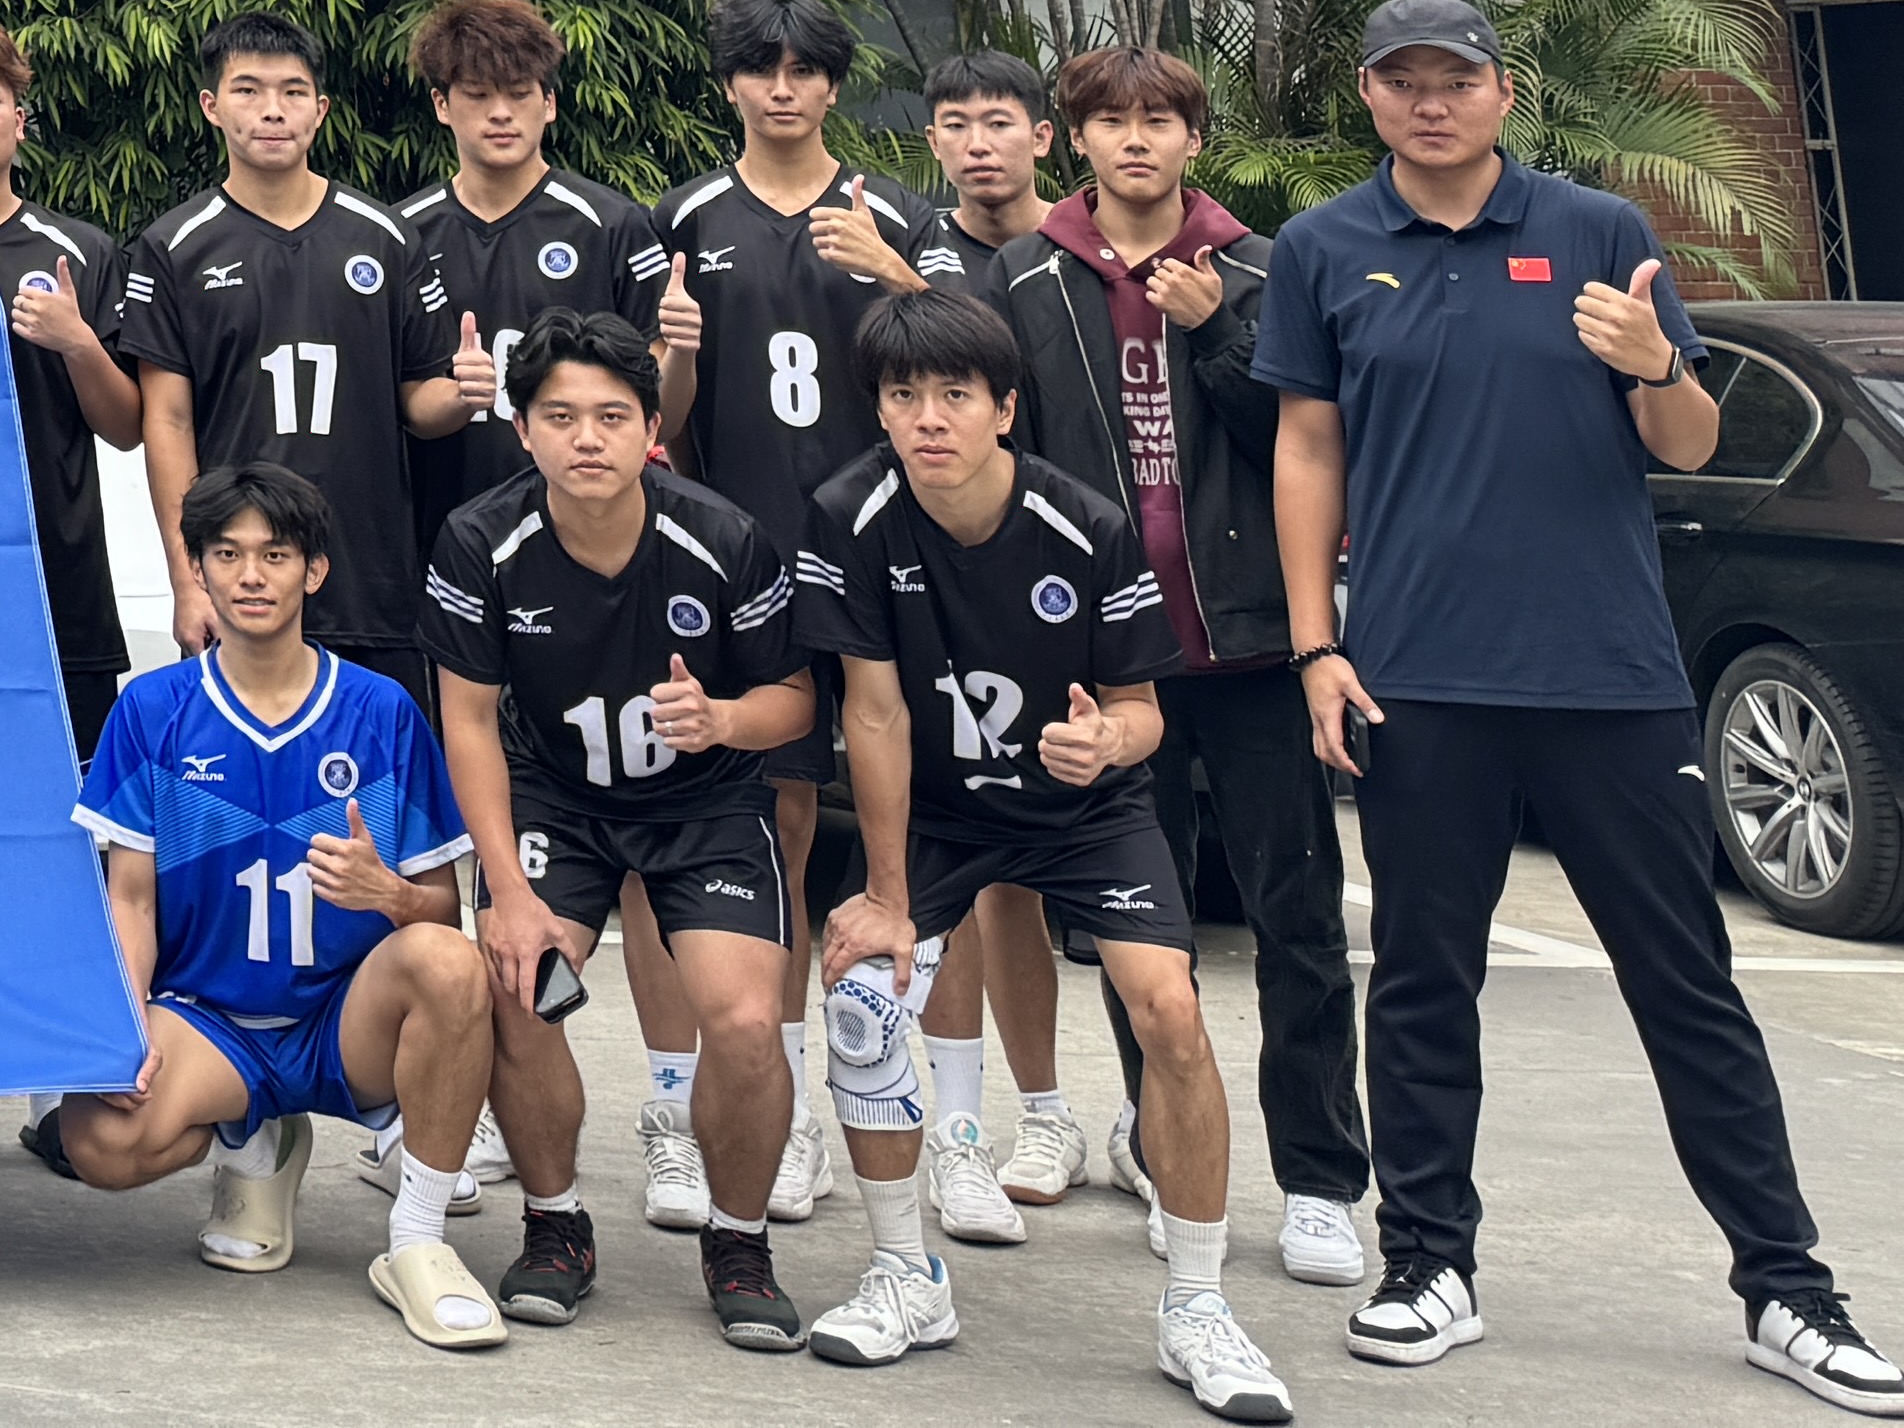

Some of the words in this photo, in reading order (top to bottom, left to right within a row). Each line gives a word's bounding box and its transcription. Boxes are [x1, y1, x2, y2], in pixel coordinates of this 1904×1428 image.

[260, 342, 337, 435] 17
[768, 330, 821, 428] 8
[563, 695, 677, 787] 16
[235, 858, 314, 967] 11
